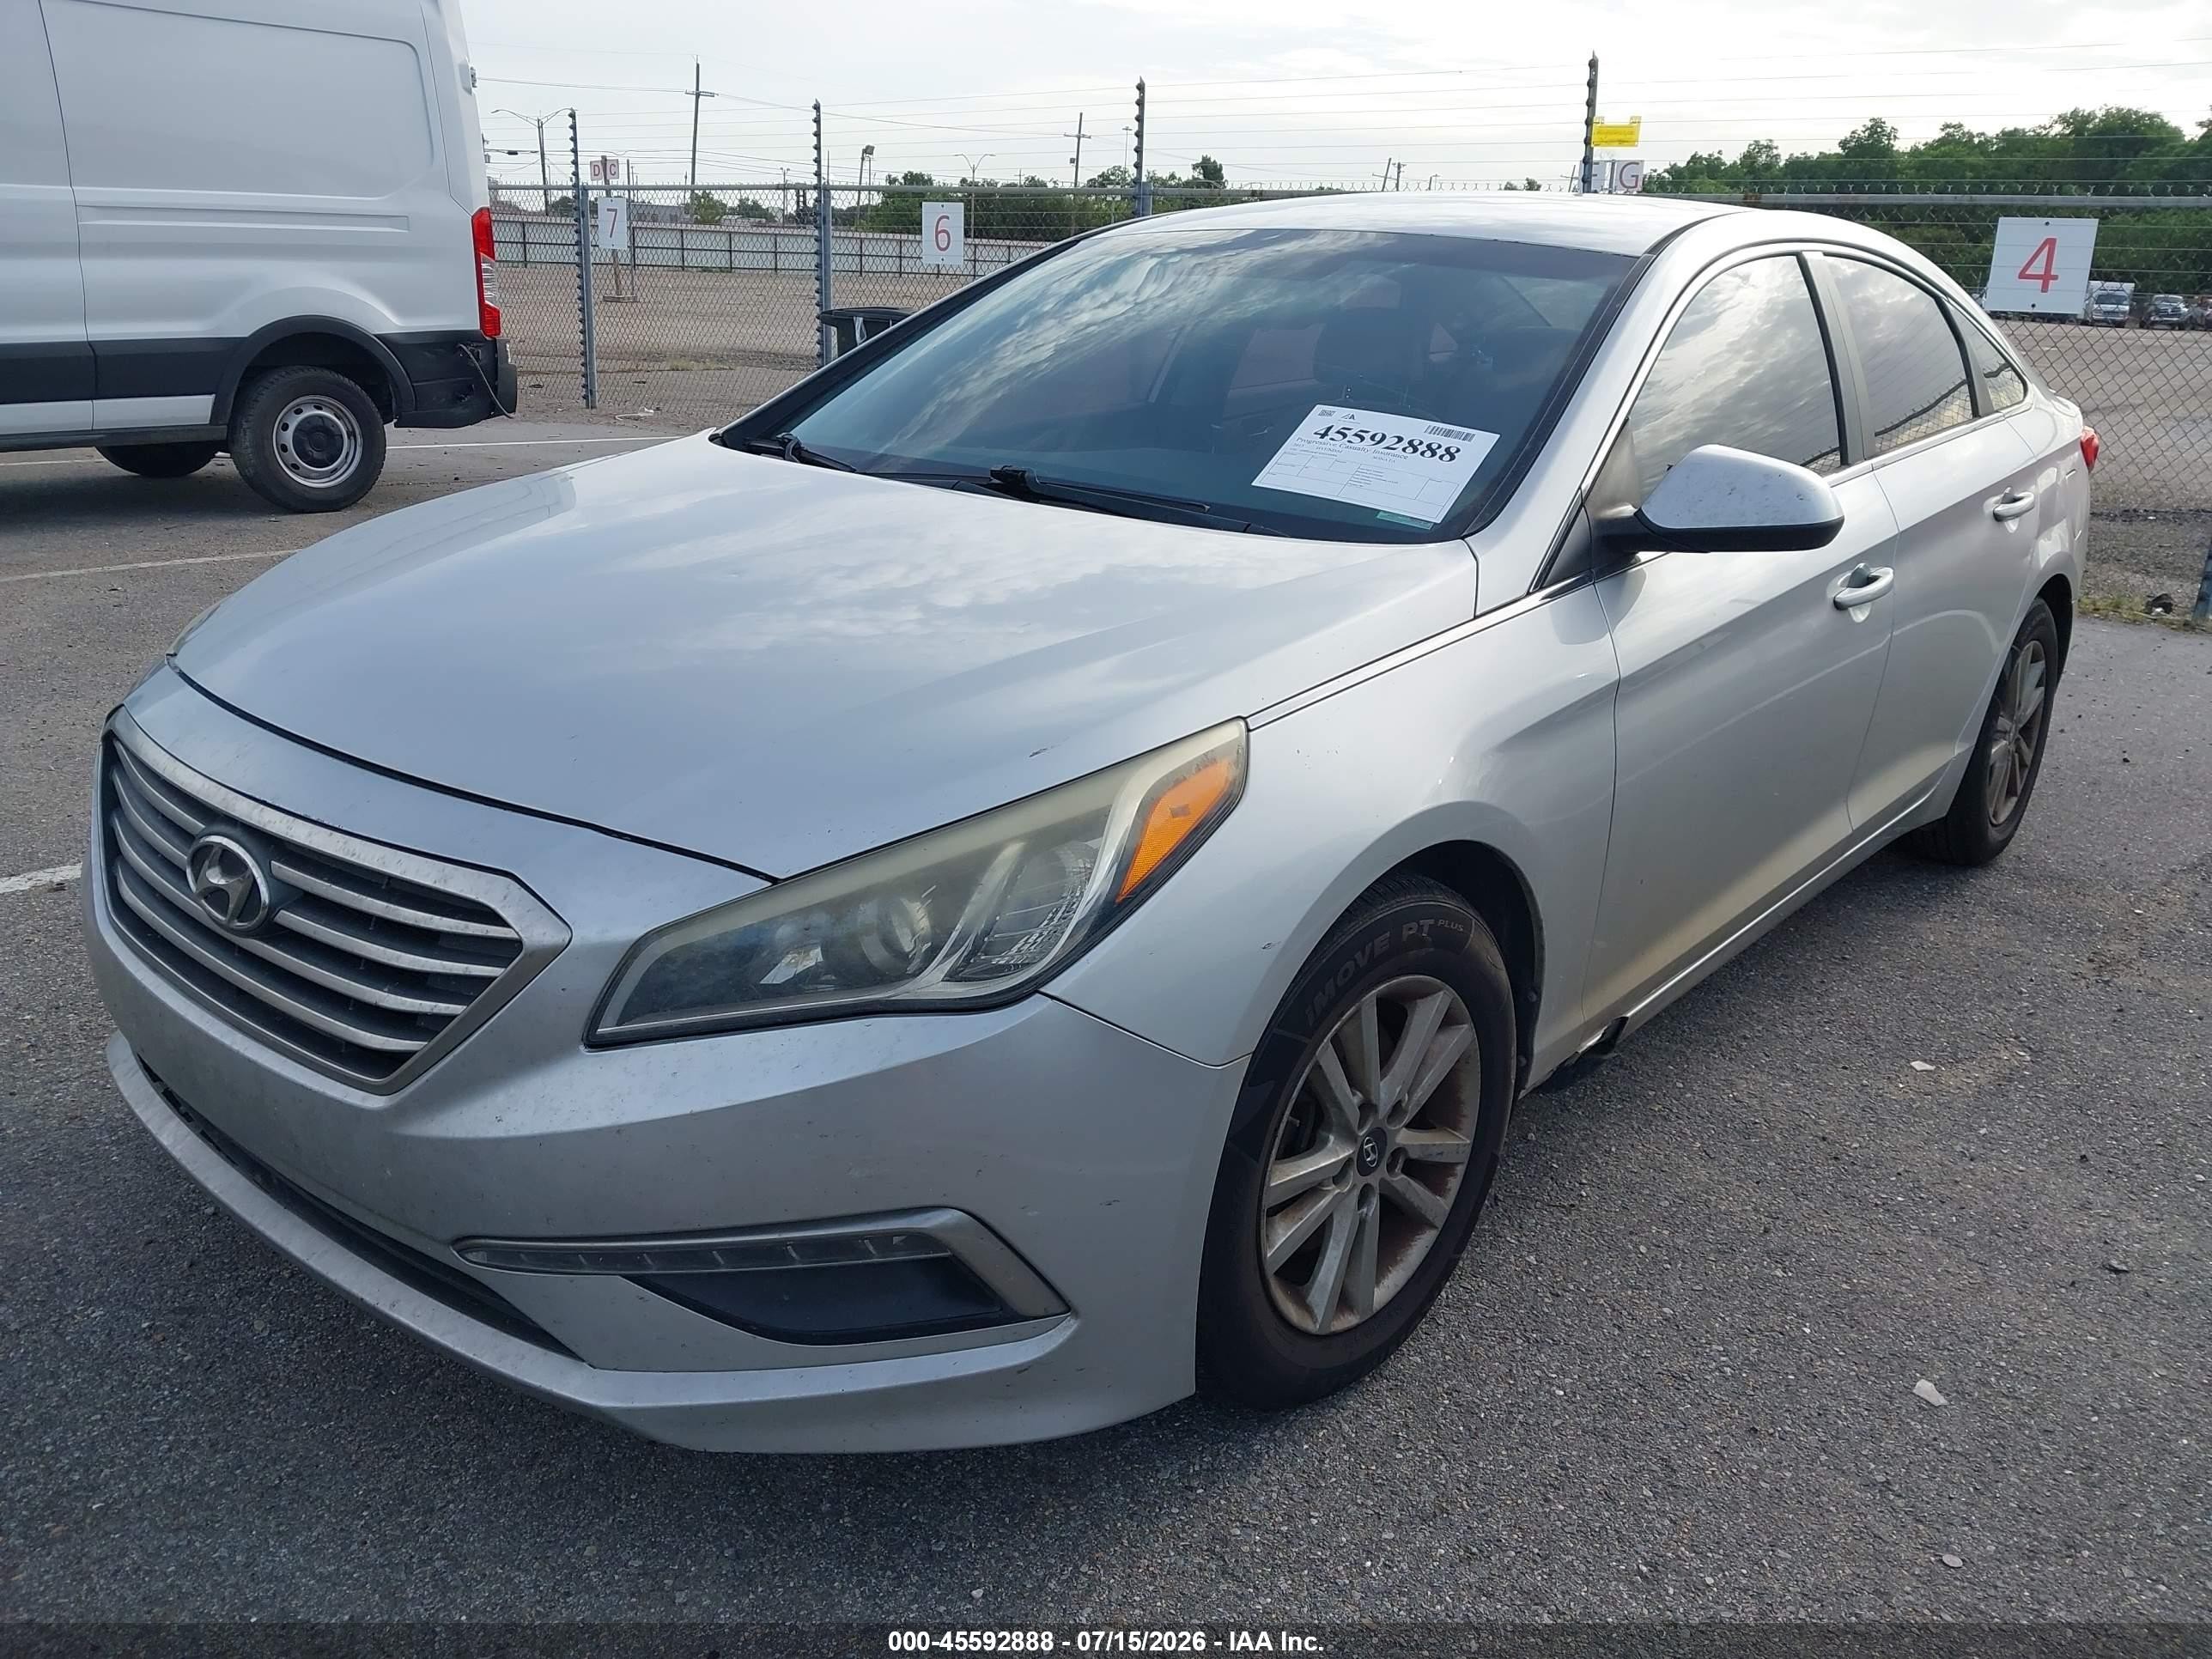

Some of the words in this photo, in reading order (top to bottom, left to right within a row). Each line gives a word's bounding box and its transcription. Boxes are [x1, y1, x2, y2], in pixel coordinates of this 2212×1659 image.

[592, 164, 601, 177] D
[609, 163, 617, 176] C
[1620, 161, 1639, 189] G
[606, 208, 618, 239] 7
[934, 214, 951, 252] 6
[2018, 237, 2059, 293] 4
[1296, 436, 1339, 448] Progressive
[1339, 442, 1370, 454] Casualty
[1373, 448, 1409, 460] Insurance
[1313, 424, 1462, 462] 45592888
[1401, 918, 1436, 942] PT
[1437, 919, 1464, 933] PLUS
